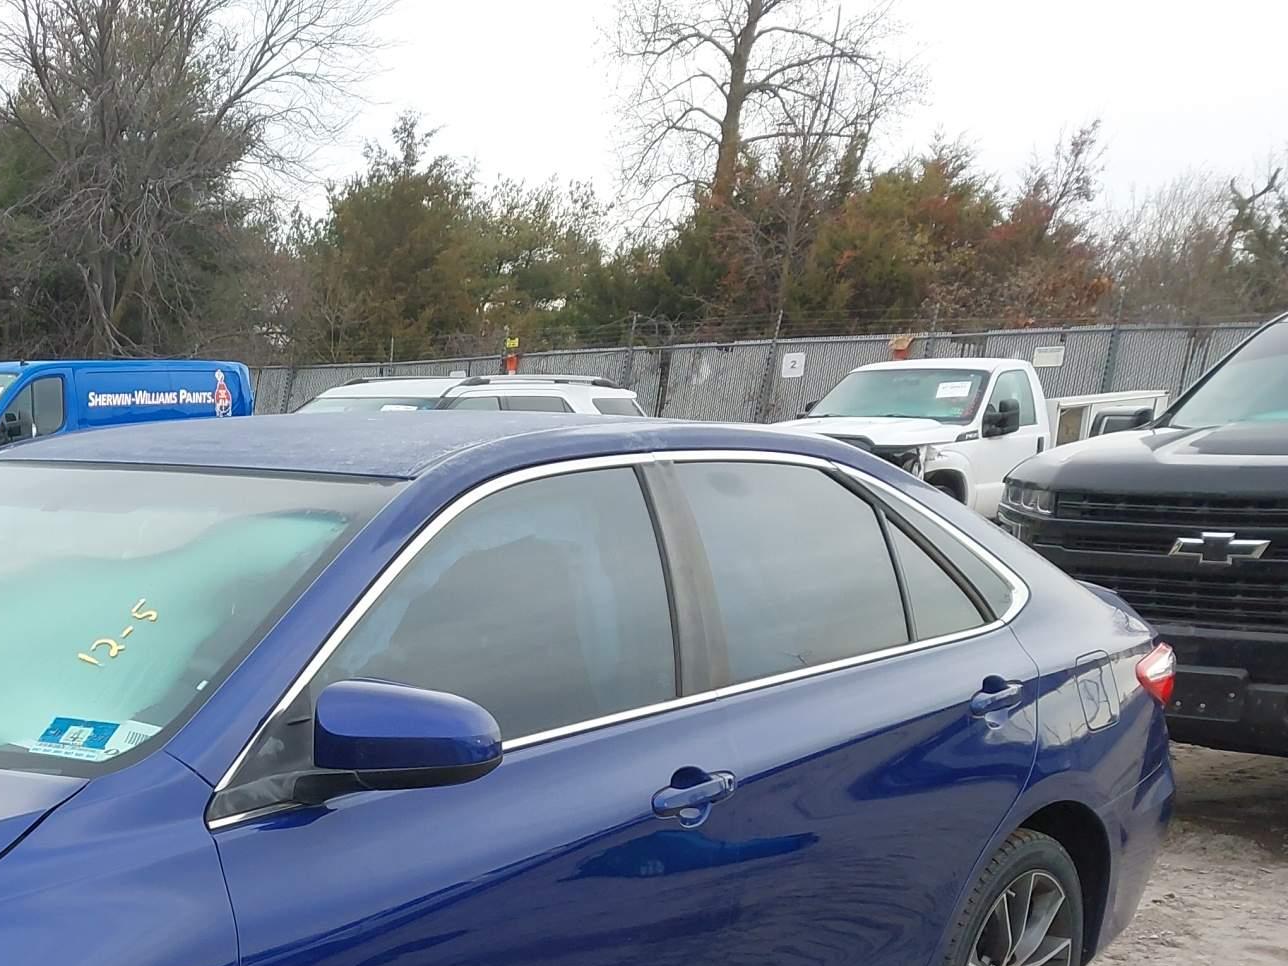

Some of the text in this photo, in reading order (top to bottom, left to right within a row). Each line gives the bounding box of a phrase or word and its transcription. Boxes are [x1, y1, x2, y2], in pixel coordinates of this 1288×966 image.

[789, 360, 798, 369] 2
[87, 389, 178, 407] SHERWIN-WILLIAMS
[77, 597, 158, 667] 12-5
